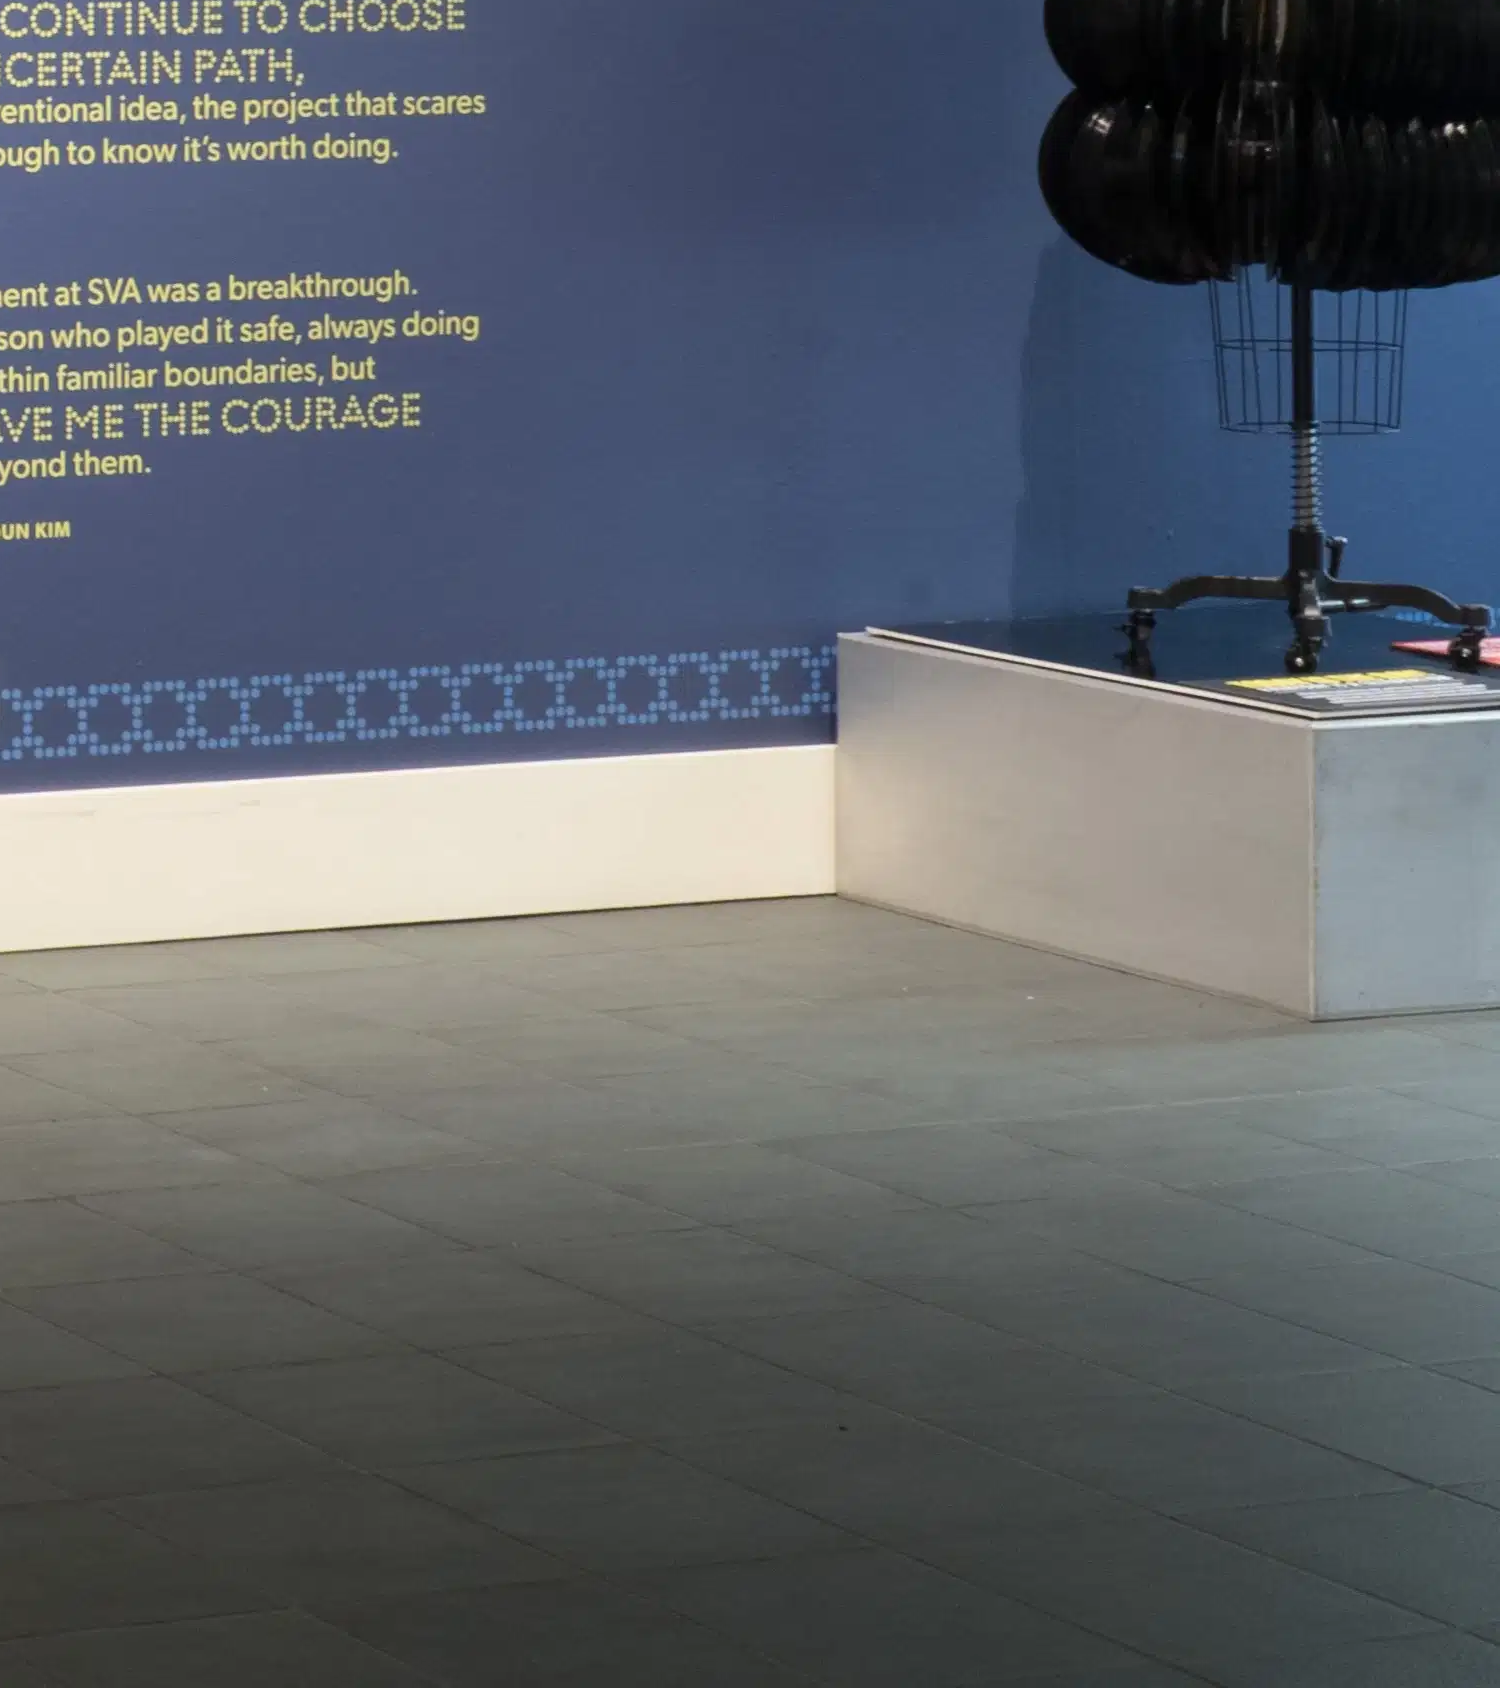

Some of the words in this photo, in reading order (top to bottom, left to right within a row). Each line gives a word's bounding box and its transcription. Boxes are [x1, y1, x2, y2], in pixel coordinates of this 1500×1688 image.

[193, 47, 305, 86] PATH,
[118, 95, 187, 125] idea,
[191, 95, 239, 122] the
[242, 95, 340, 125] project
[344, 91, 398, 118] that
[403, 94, 486, 117] scares
[66, 143, 98, 166] to
[101, 138, 179, 165] know
[225, 135, 308, 162] worth
[311, 135, 398, 165] doing.
